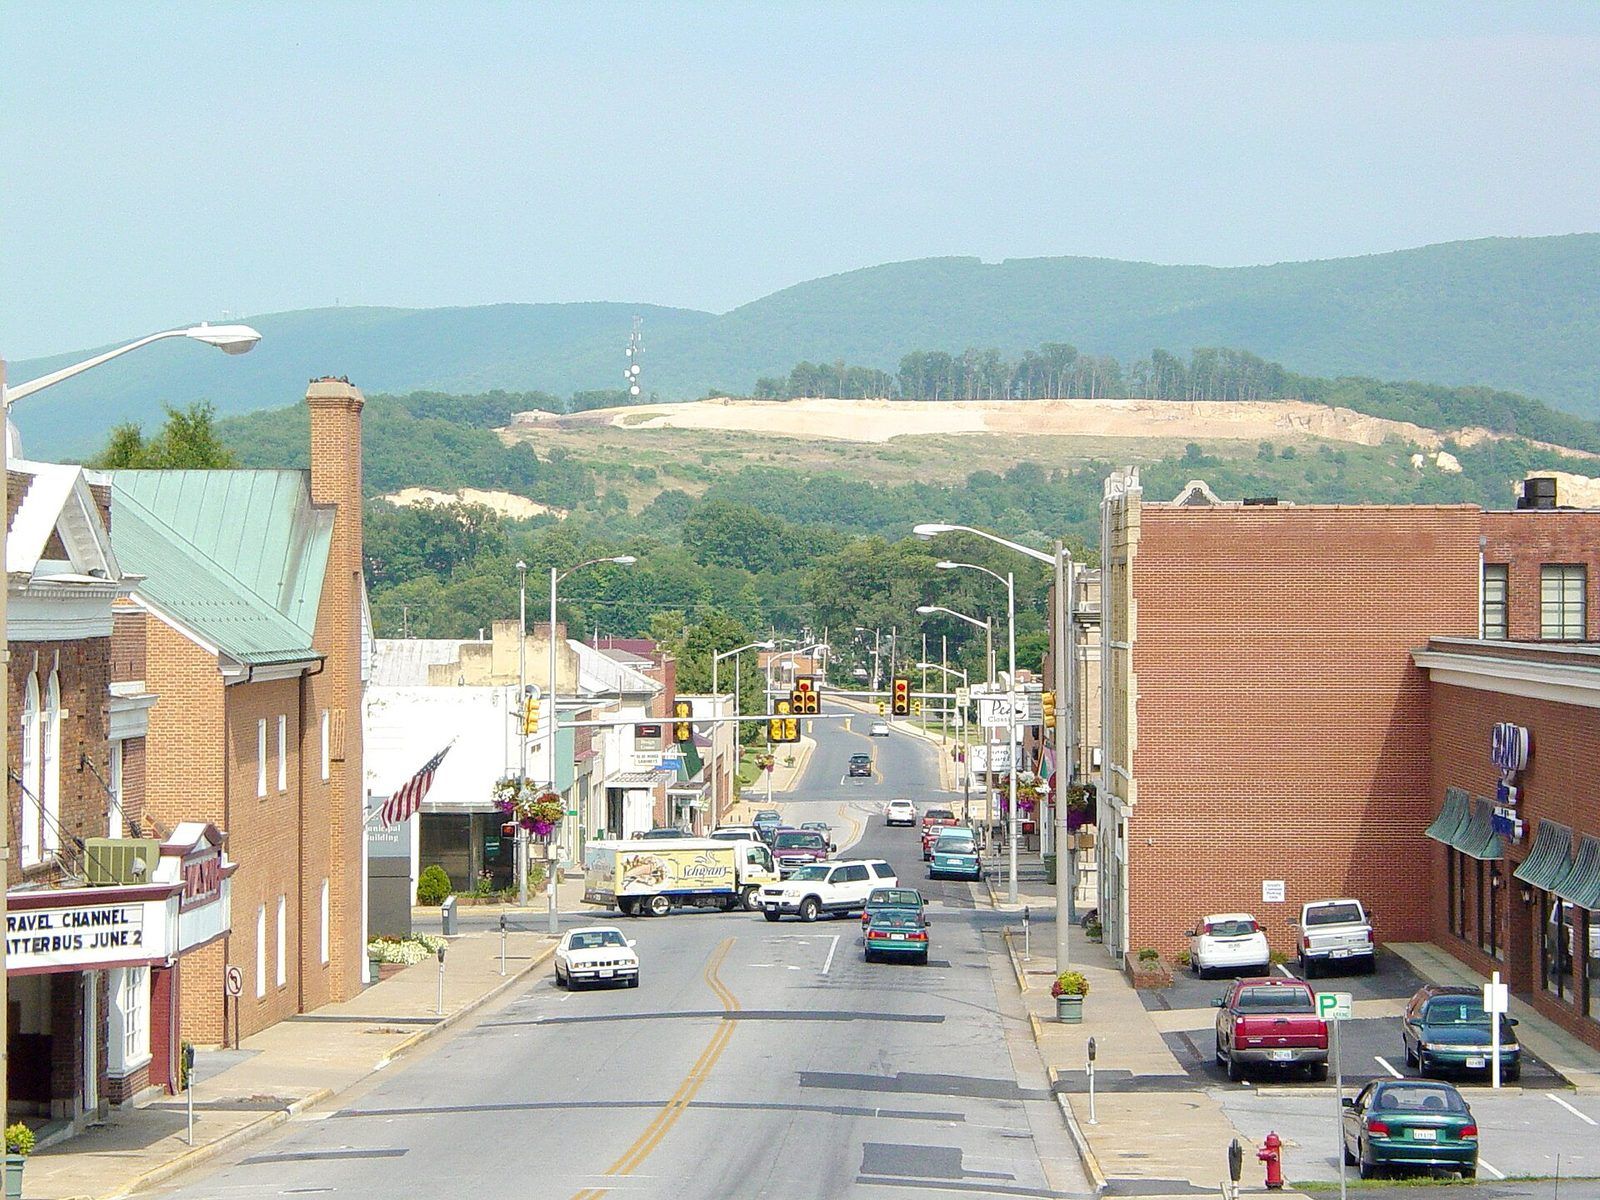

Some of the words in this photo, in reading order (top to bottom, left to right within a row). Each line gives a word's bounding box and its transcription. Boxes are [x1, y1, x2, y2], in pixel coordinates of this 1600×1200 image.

[367, 833, 399, 843] uilding
[7, 914, 53, 932] RAVEL
[62, 909, 128, 928] CHANNEL
[90, 931, 128, 949] JUNE
[133, 930, 142, 945] 2
[1319, 995, 1338, 1018] P
